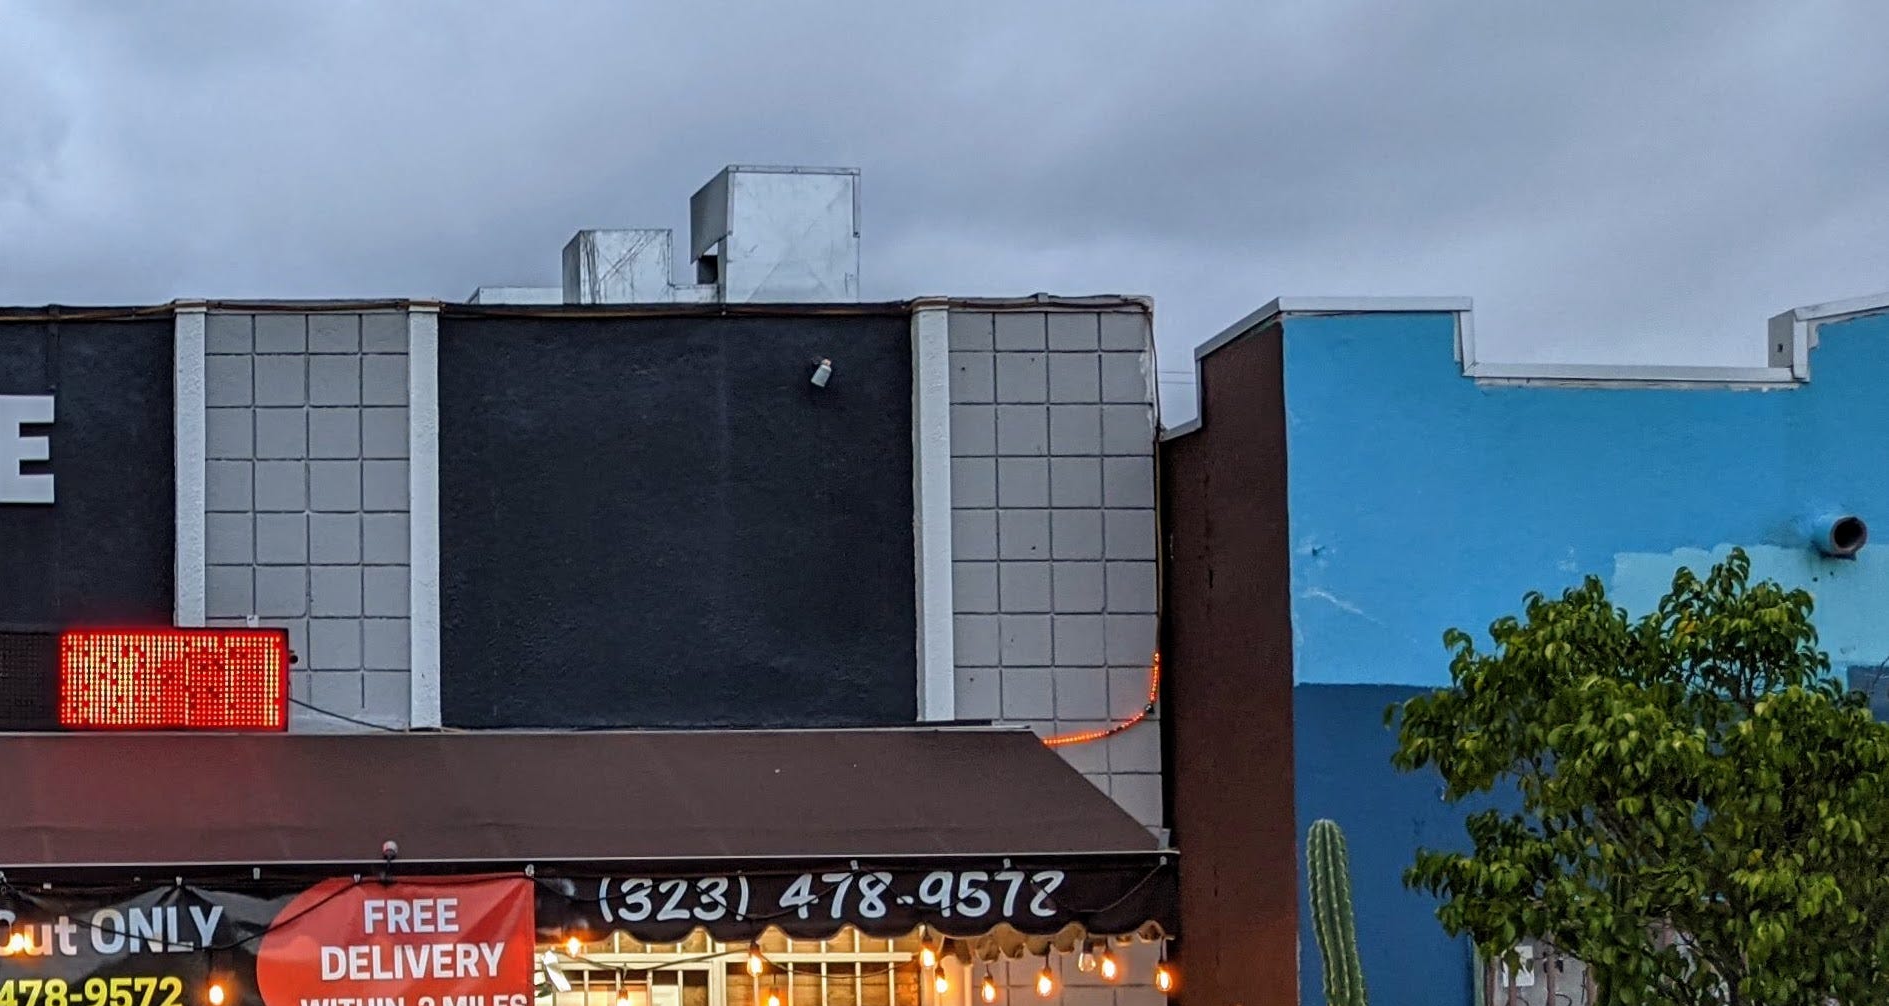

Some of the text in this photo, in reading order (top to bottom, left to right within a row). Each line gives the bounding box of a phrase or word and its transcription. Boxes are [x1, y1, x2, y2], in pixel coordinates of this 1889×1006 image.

[363, 898, 460, 934] FREE
[598, 870, 1065, 923] (323) 478-9572
[90, 905, 223, 955] ONLY
[320, 942, 504, 982] DELIVERY
